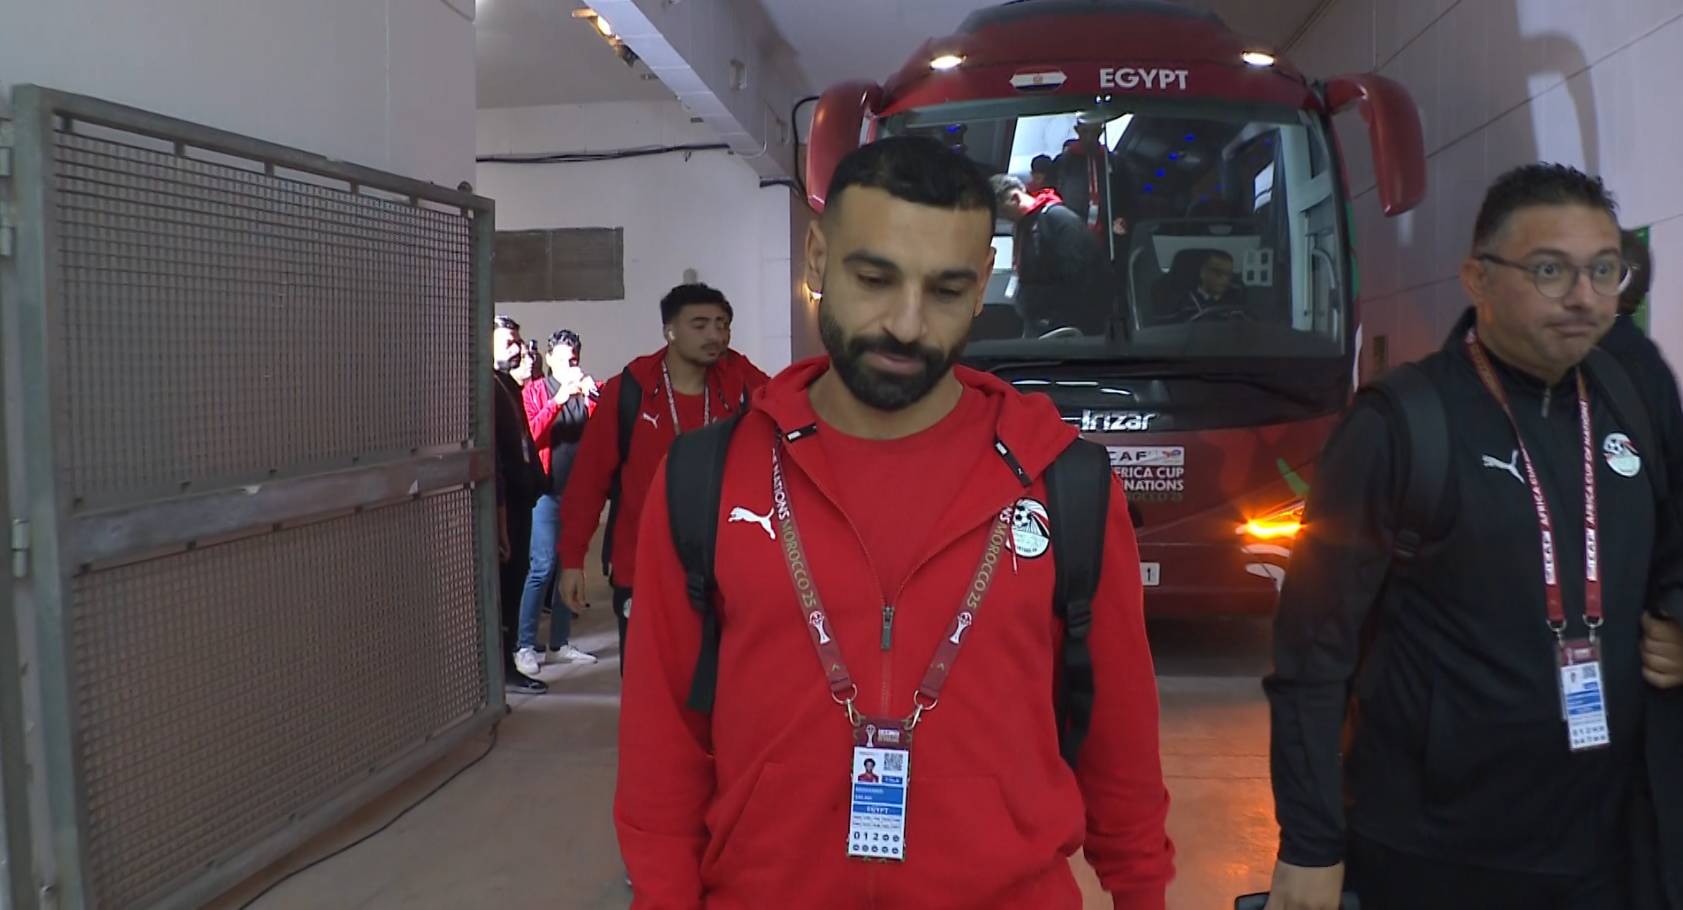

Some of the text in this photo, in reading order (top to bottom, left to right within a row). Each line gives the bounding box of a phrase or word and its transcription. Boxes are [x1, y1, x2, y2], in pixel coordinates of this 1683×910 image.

[1099, 67, 1188, 90] EGYPT
[1081, 408, 1156, 431] Irizar
[1112, 466, 1184, 478] FRICA CUP
[1123, 479, 1184, 491] NATIONS
[1532, 486, 1549, 526] AFRICA
[780, 519, 810, 590] MOROCCO
[801, 591, 817, 608] 25
[974, 521, 1008, 592] MOROCCO
[967, 591, 981, 609] 25
[854, 831, 879, 841] 0 1 2
